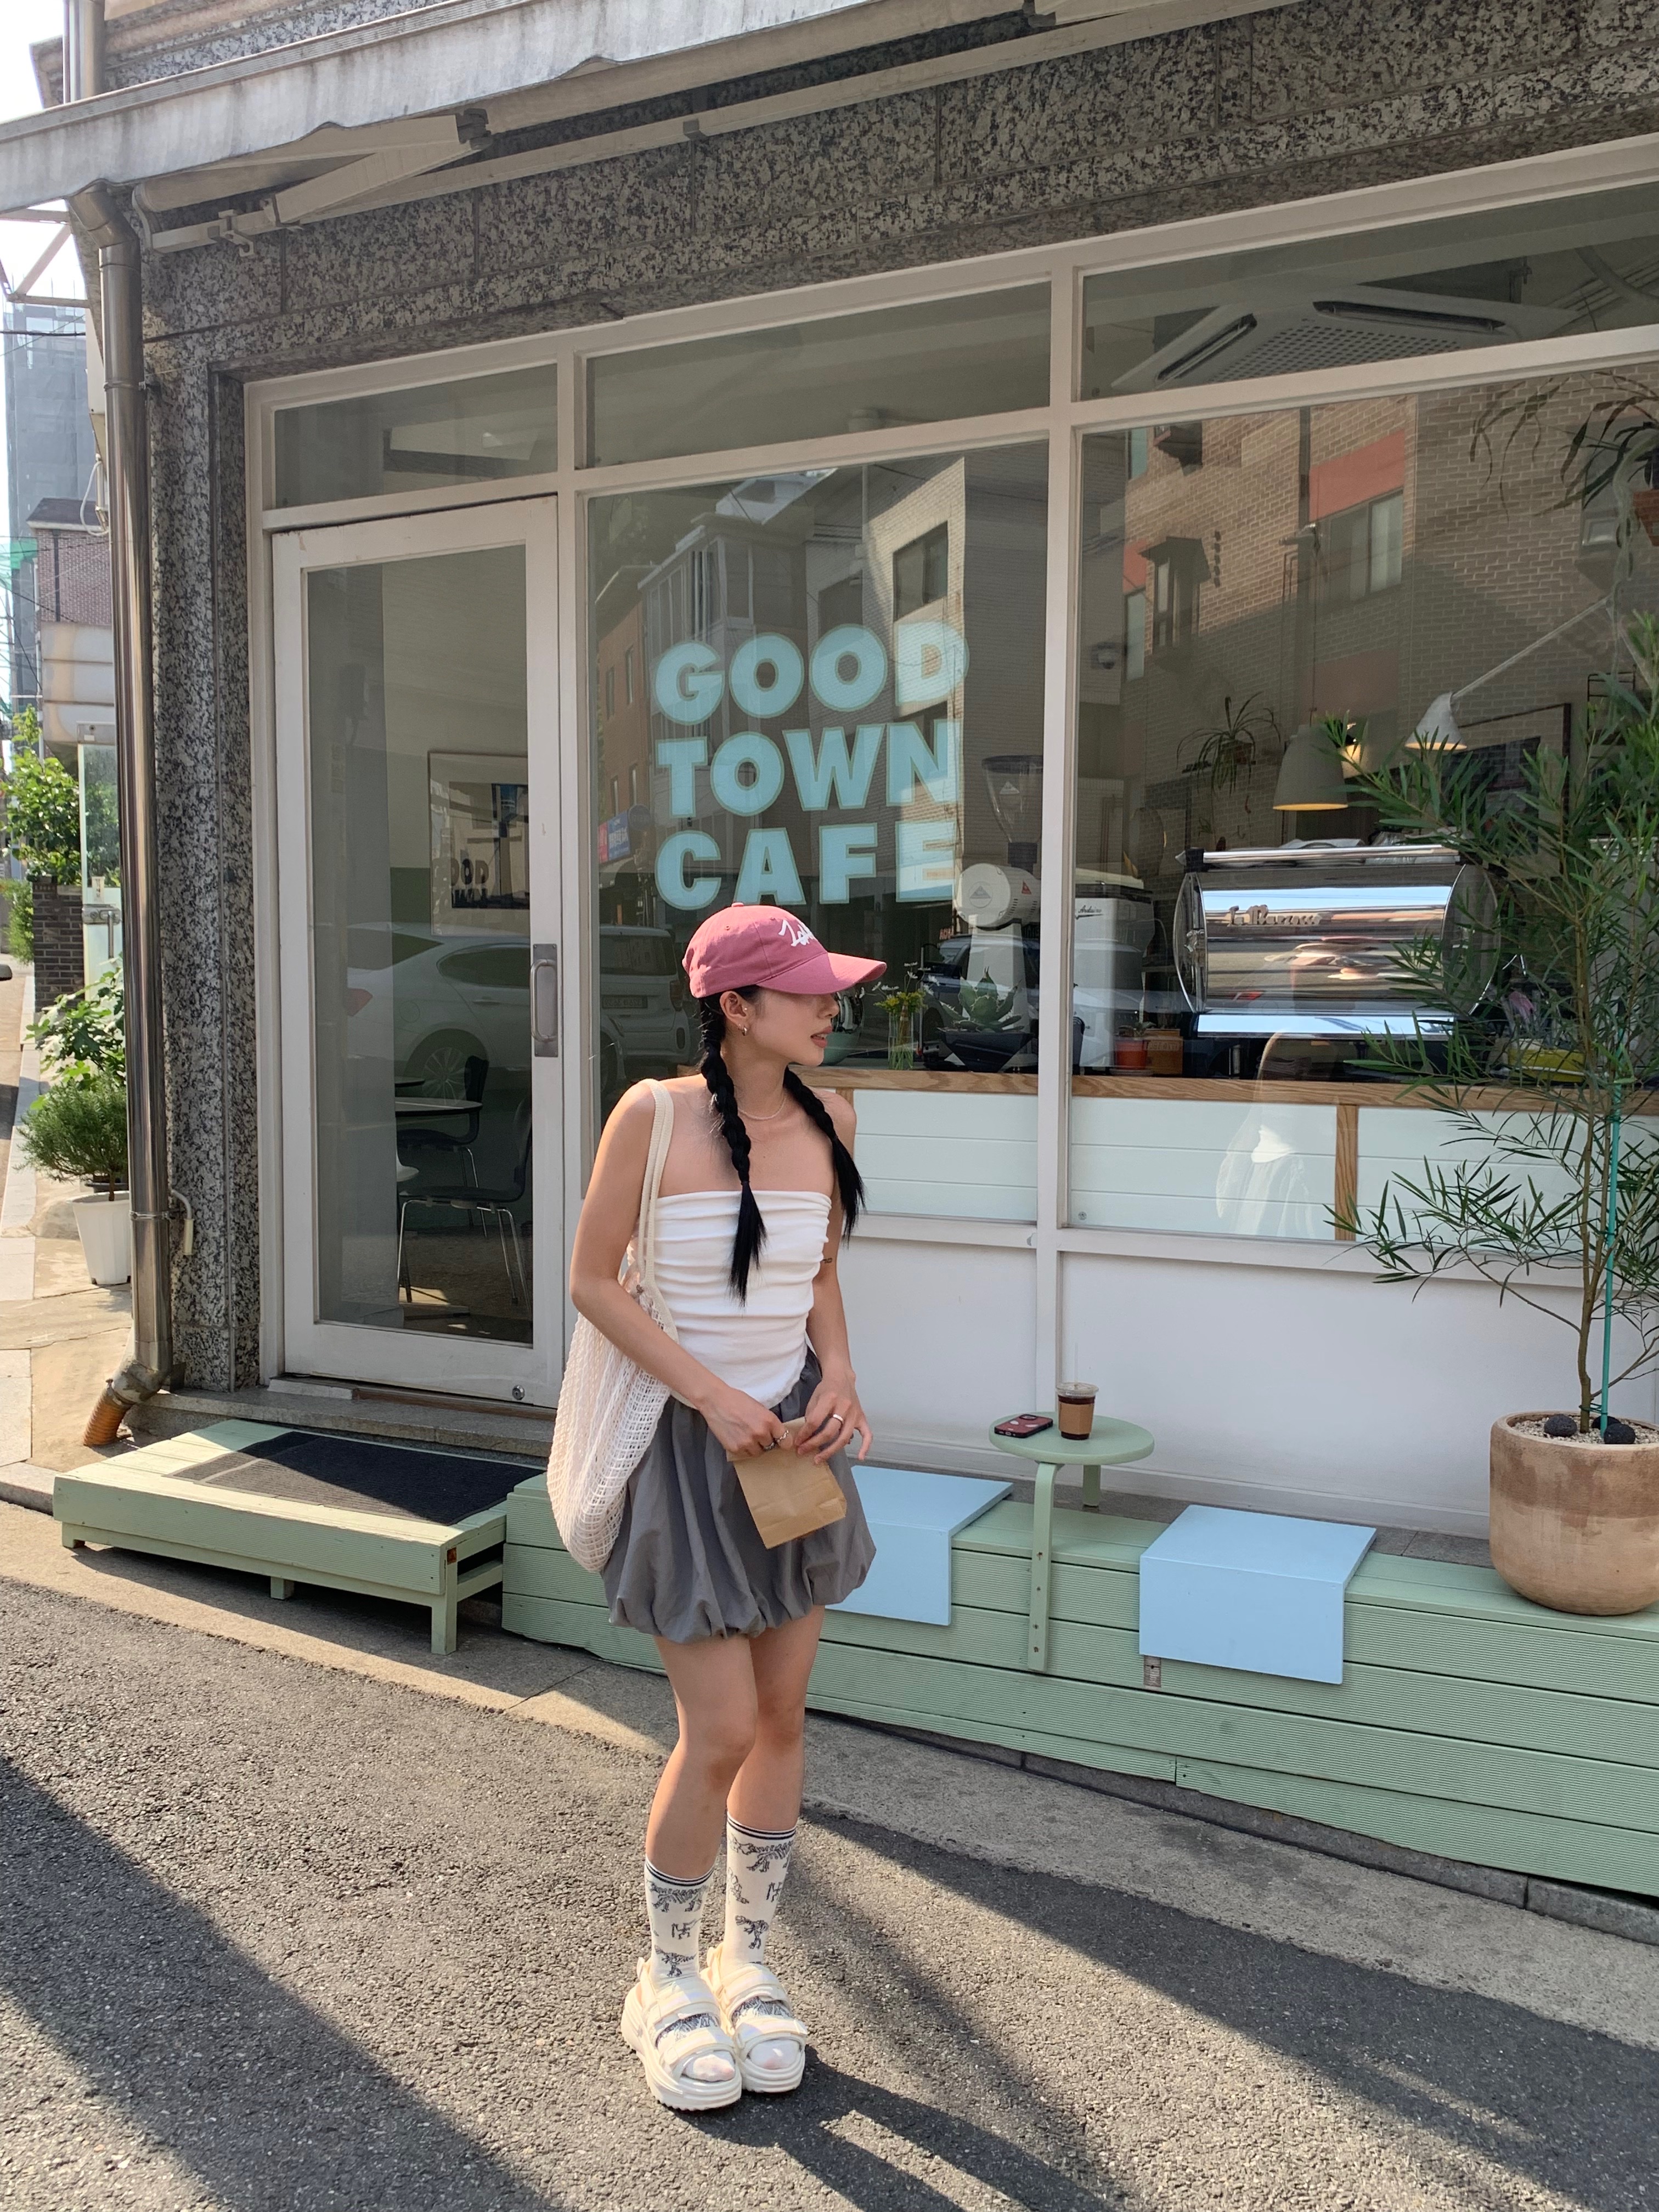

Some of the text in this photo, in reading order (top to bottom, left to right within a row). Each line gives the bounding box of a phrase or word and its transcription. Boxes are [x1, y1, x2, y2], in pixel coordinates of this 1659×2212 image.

[653, 620, 970, 725] GOOD
[655, 719, 963, 819] TOWN
[654, 820, 957, 911] CAFE
